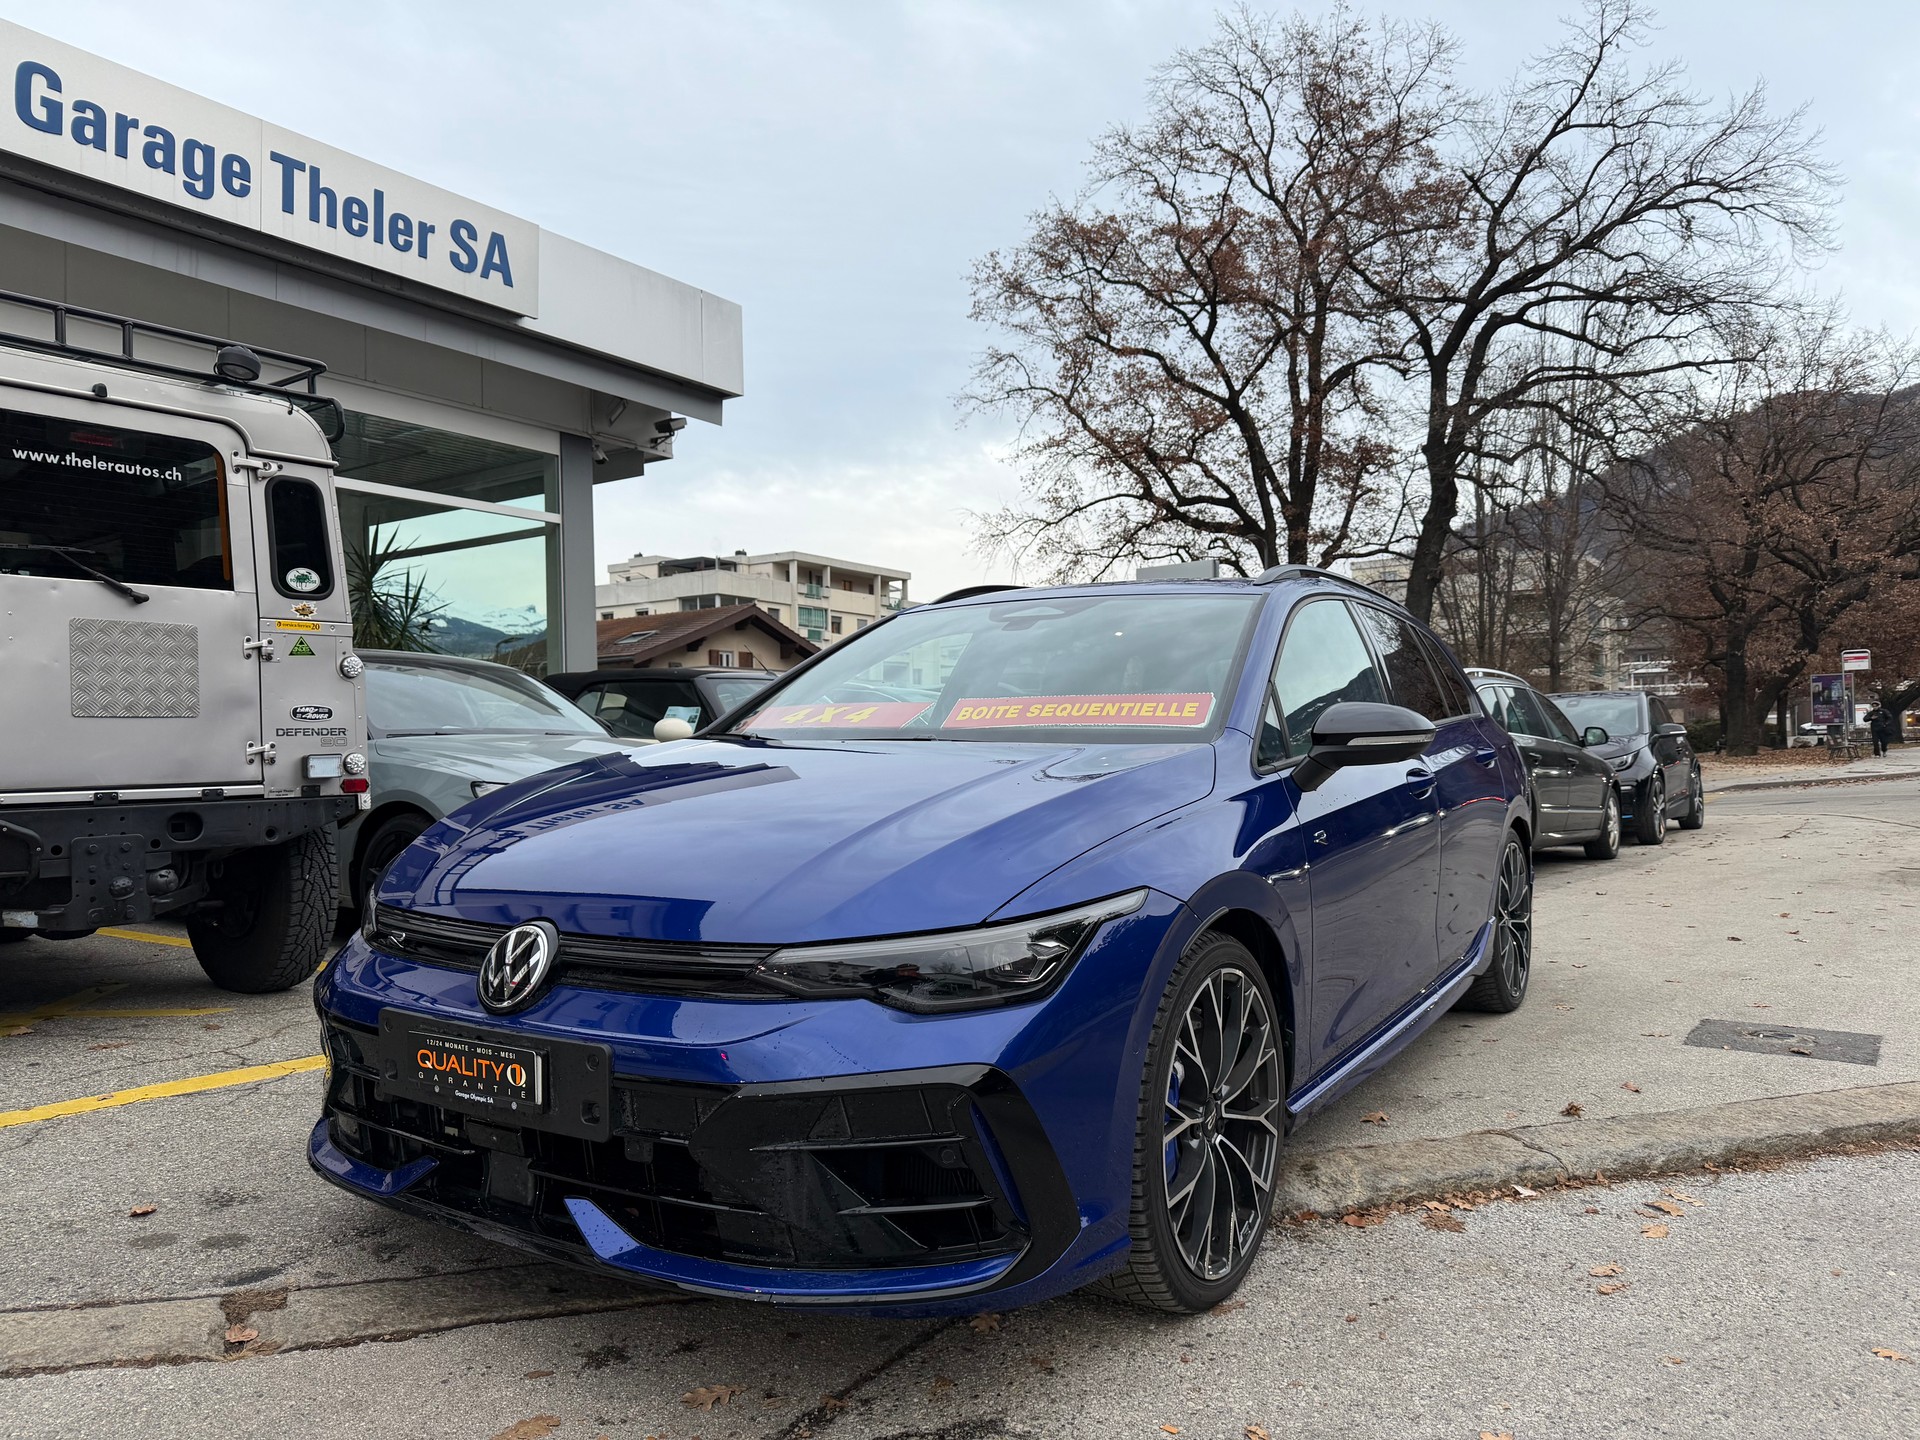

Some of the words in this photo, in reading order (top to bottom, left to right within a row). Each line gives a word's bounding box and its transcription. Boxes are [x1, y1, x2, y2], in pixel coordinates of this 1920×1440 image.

[15, 60, 252, 199] Garage
[270, 151, 435, 259] Theler
[449, 219, 514, 288] SA
[12, 449, 182, 481] www.thelerautos.ch
[956, 705, 1023, 721] BOITE
[1026, 702, 1199, 717] SEQUENTIELLE
[276, 728, 347, 737] DEFENDER
[321, 737, 347, 747] 90
[426, 1039, 443, 1047] 12/24
[444, 1041, 469, 1051] MONATE
[476, 1047, 492, 1056] MOIS
[500, 1051, 516, 1059] MESI
[417, 1049, 504, 1081] QUALITY
[418, 1071, 526, 1099] GARANTIE
[455, 1089, 469, 1099] Garage
[470, 1091, 487, 1103] Olympic
